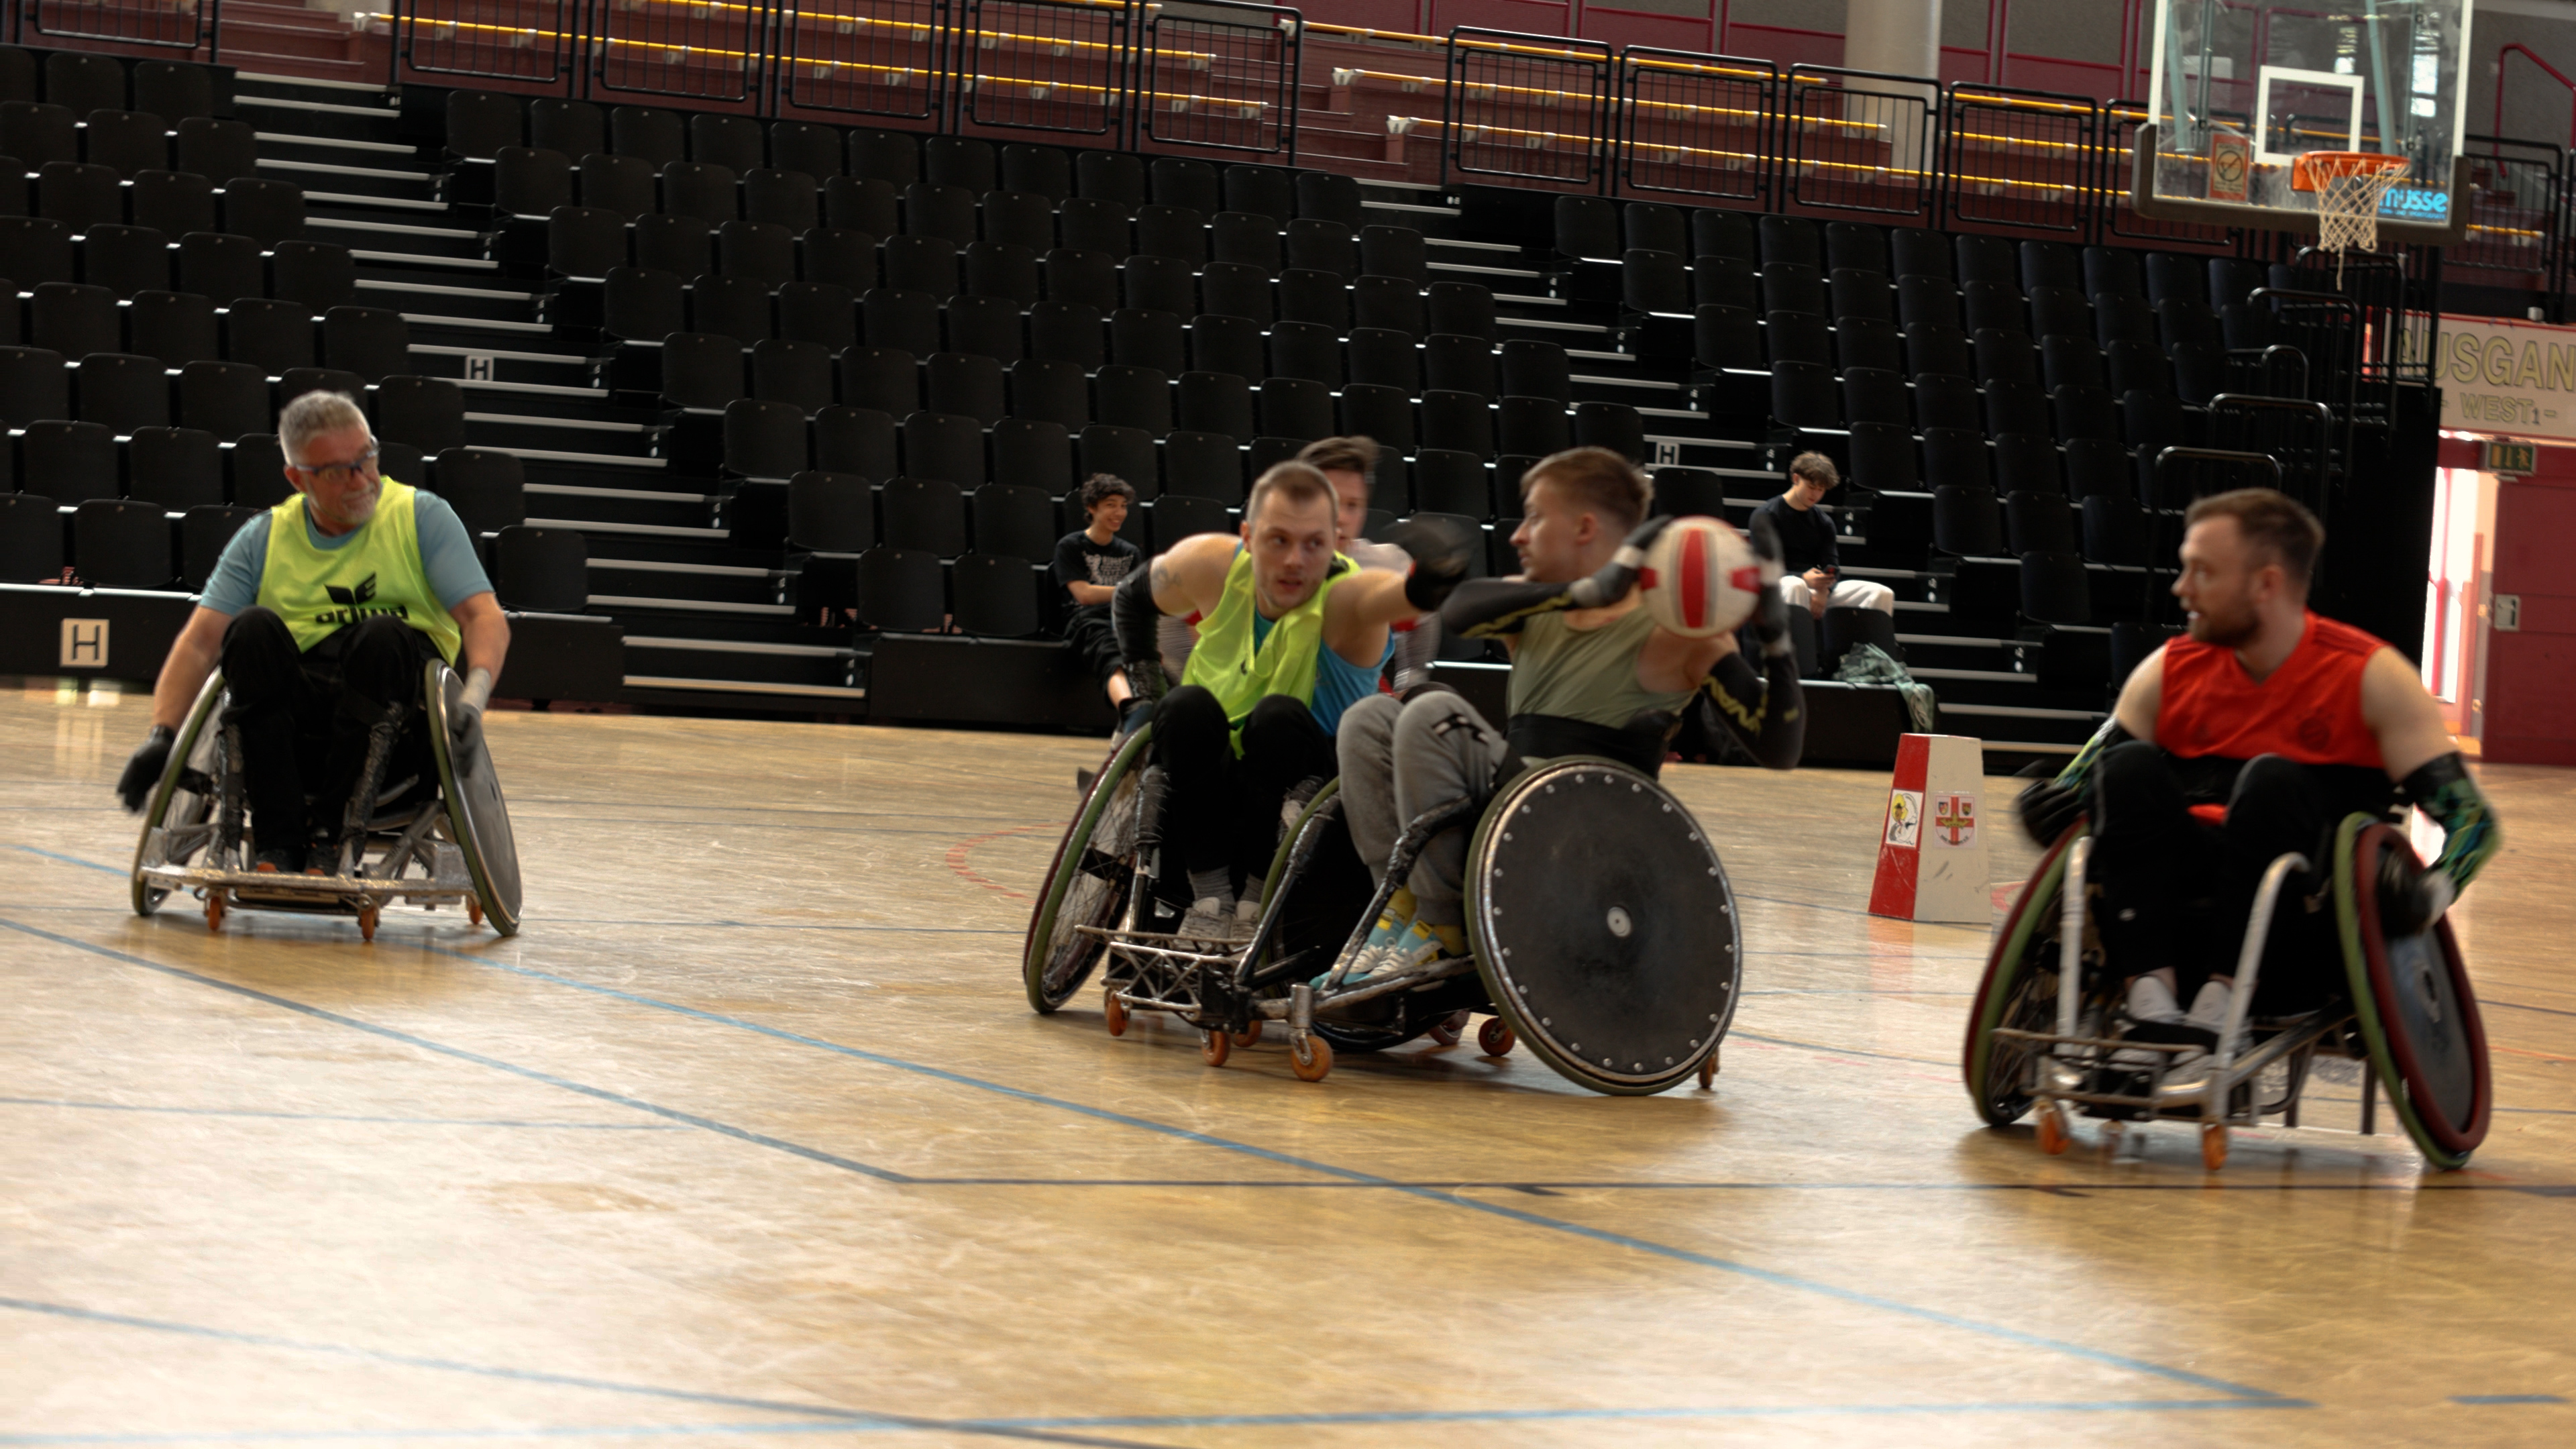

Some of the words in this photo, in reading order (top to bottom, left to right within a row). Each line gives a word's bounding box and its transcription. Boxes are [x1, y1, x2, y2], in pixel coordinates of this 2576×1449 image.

[470, 358, 490, 380] H
[1660, 445, 1676, 464] H
[71, 624, 101, 661] H
